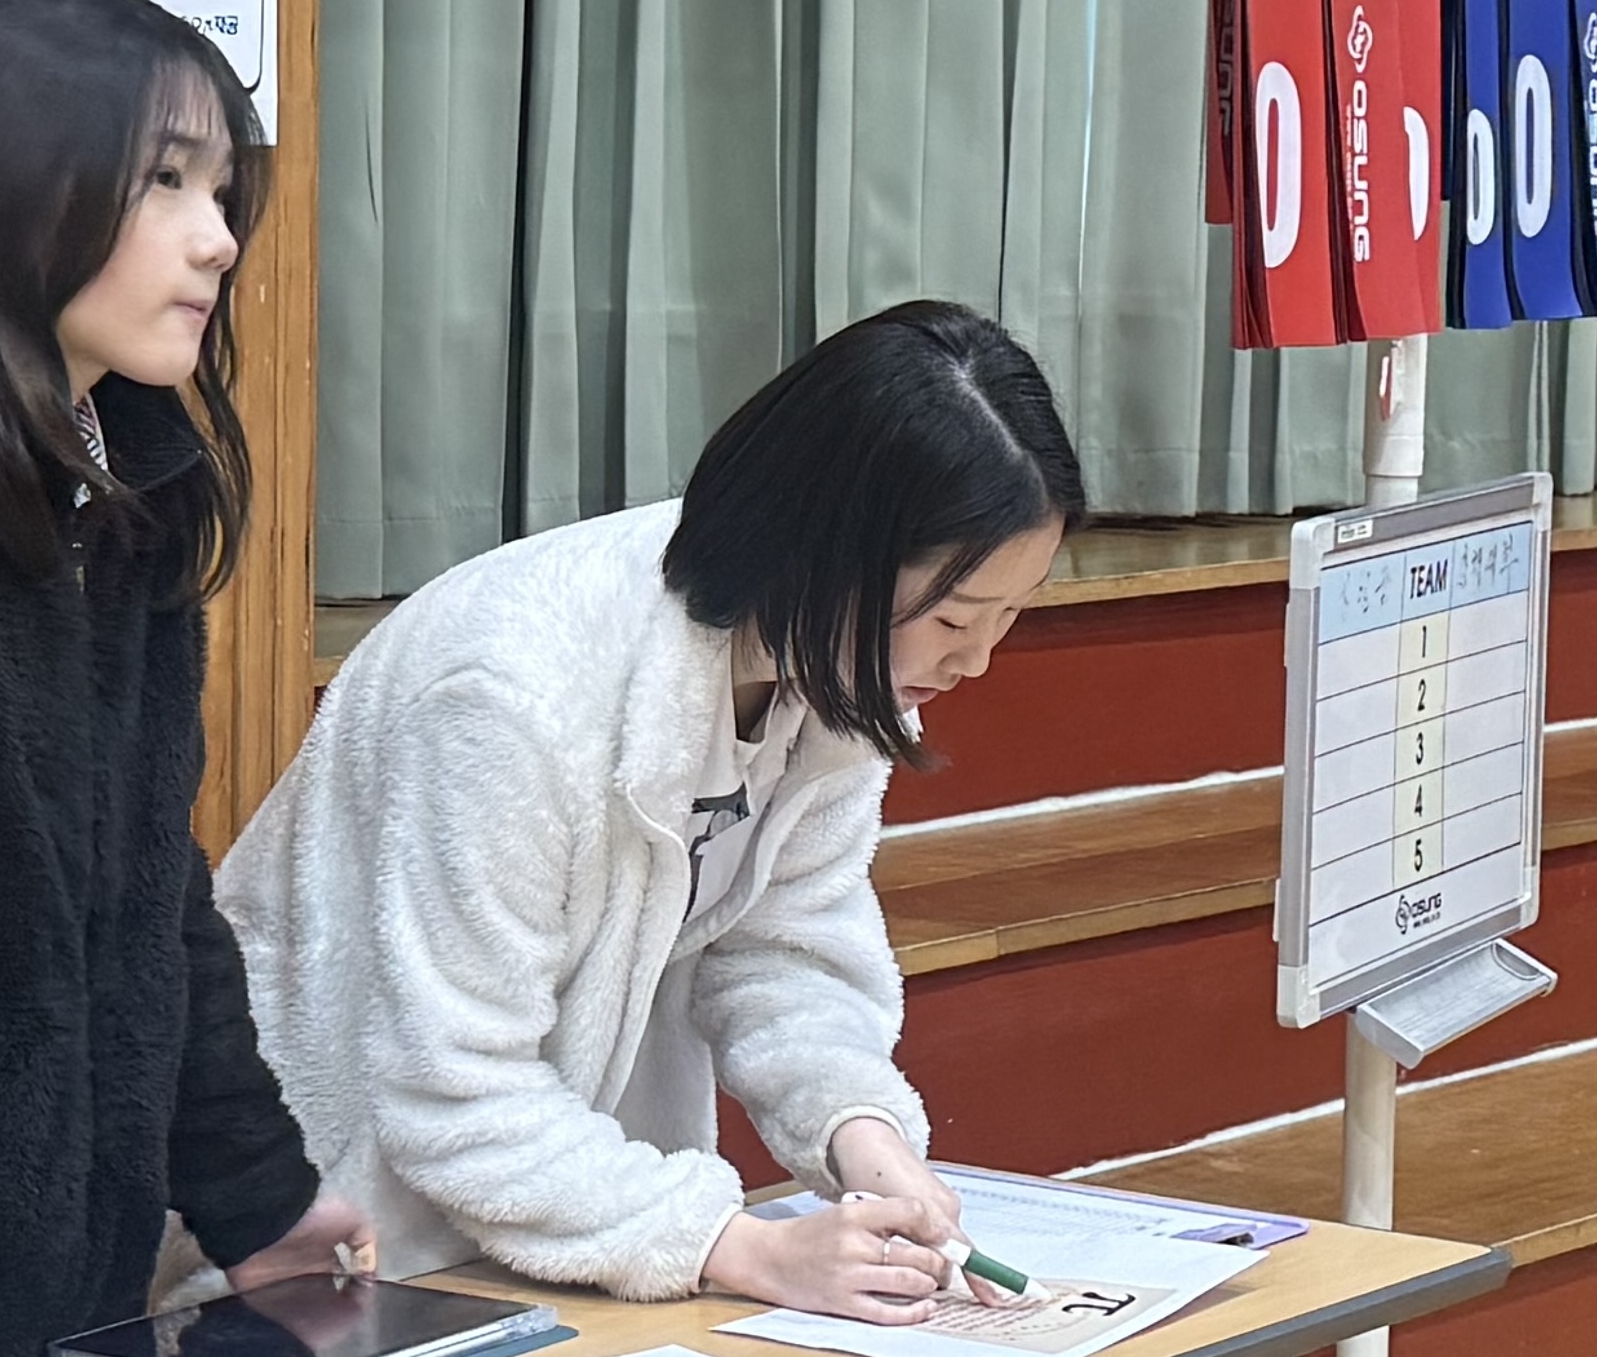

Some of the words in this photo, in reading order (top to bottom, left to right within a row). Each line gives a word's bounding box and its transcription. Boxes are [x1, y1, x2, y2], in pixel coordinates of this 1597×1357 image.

[1515, 54, 1551, 238] 0
[1410, 558, 1448, 599] TEAM
[1420, 626, 1427, 657] 1
[1418, 679, 1426, 711] 2
[1415, 733, 1424, 765] 3
[1414, 786, 1423, 817] 4
[1414, 839, 1423, 872] 5
